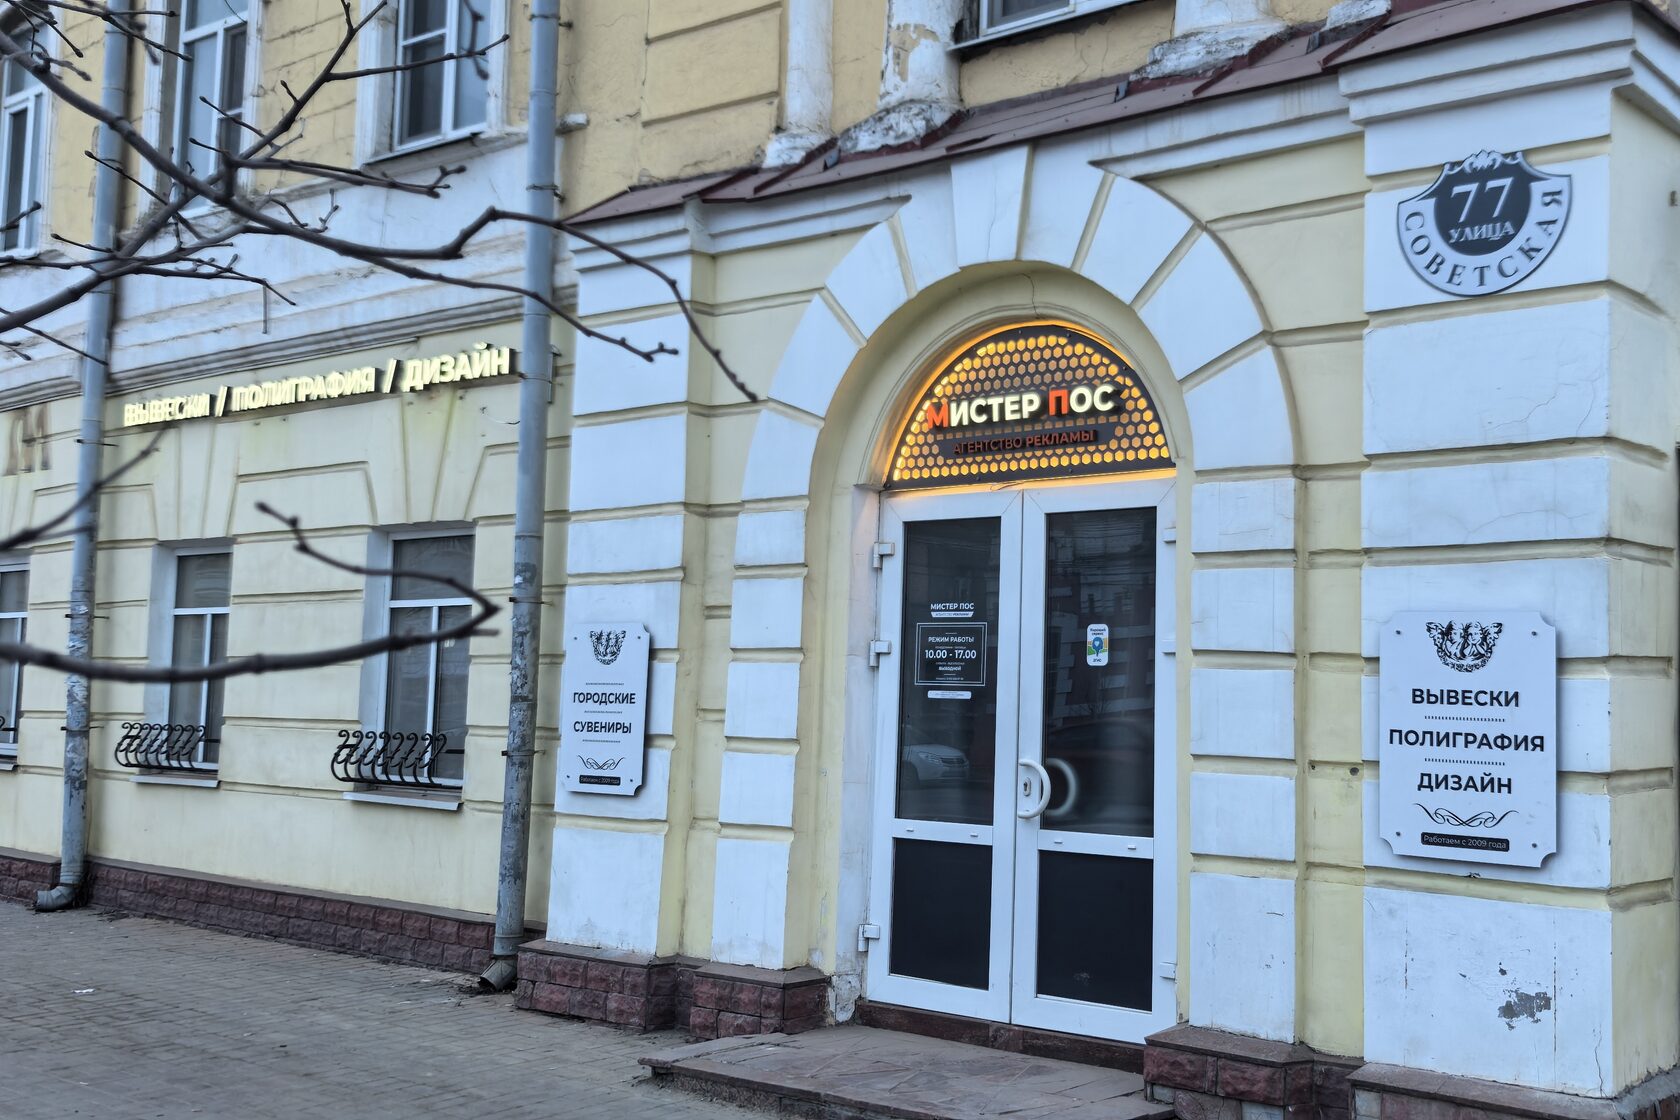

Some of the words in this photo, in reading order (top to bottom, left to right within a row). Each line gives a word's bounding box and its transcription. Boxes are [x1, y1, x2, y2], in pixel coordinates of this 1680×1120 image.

[1451, 177, 1514, 223] 77
[1405, 189, 1563, 287] СОВЕТСКАЯ
[1449, 221, 1515, 243] УЛИЦА
[124, 393, 210, 426] ВЫВЕСКИ
[232, 367, 375, 411] ПОЛИГРАФИЯ
[402, 342, 511, 392] ДИЗАЙН
[927, 391, 1041, 430] МИСТЕР
[1048, 384, 1116, 416] ПОС
[953, 437, 1022, 454] АГЕНТСТВО
[1025, 430, 1096, 447] РЕКЛАМЫ
[930, 602, 958, 610] МИСТЕР
[960, 602, 975, 610] ПОС
[925, 650, 948, 659] 10.00
[955, 650, 977, 659] 17.00
[573, 692, 636, 705] ГОРОДСКИЕ
[1411, 688, 1519, 707] ВЫВЕСКИ
[573, 720, 632, 734] СУВЕНИРЫ
[1389, 729, 1545, 752] ПОЛИГРАФИЯ
[1417, 772, 1512, 794] ДИЗАЙН
[1423, 834, 1460, 845] Работаем
[1468, 839, 1487, 847] 2009
[1488, 841, 1507, 850] года
